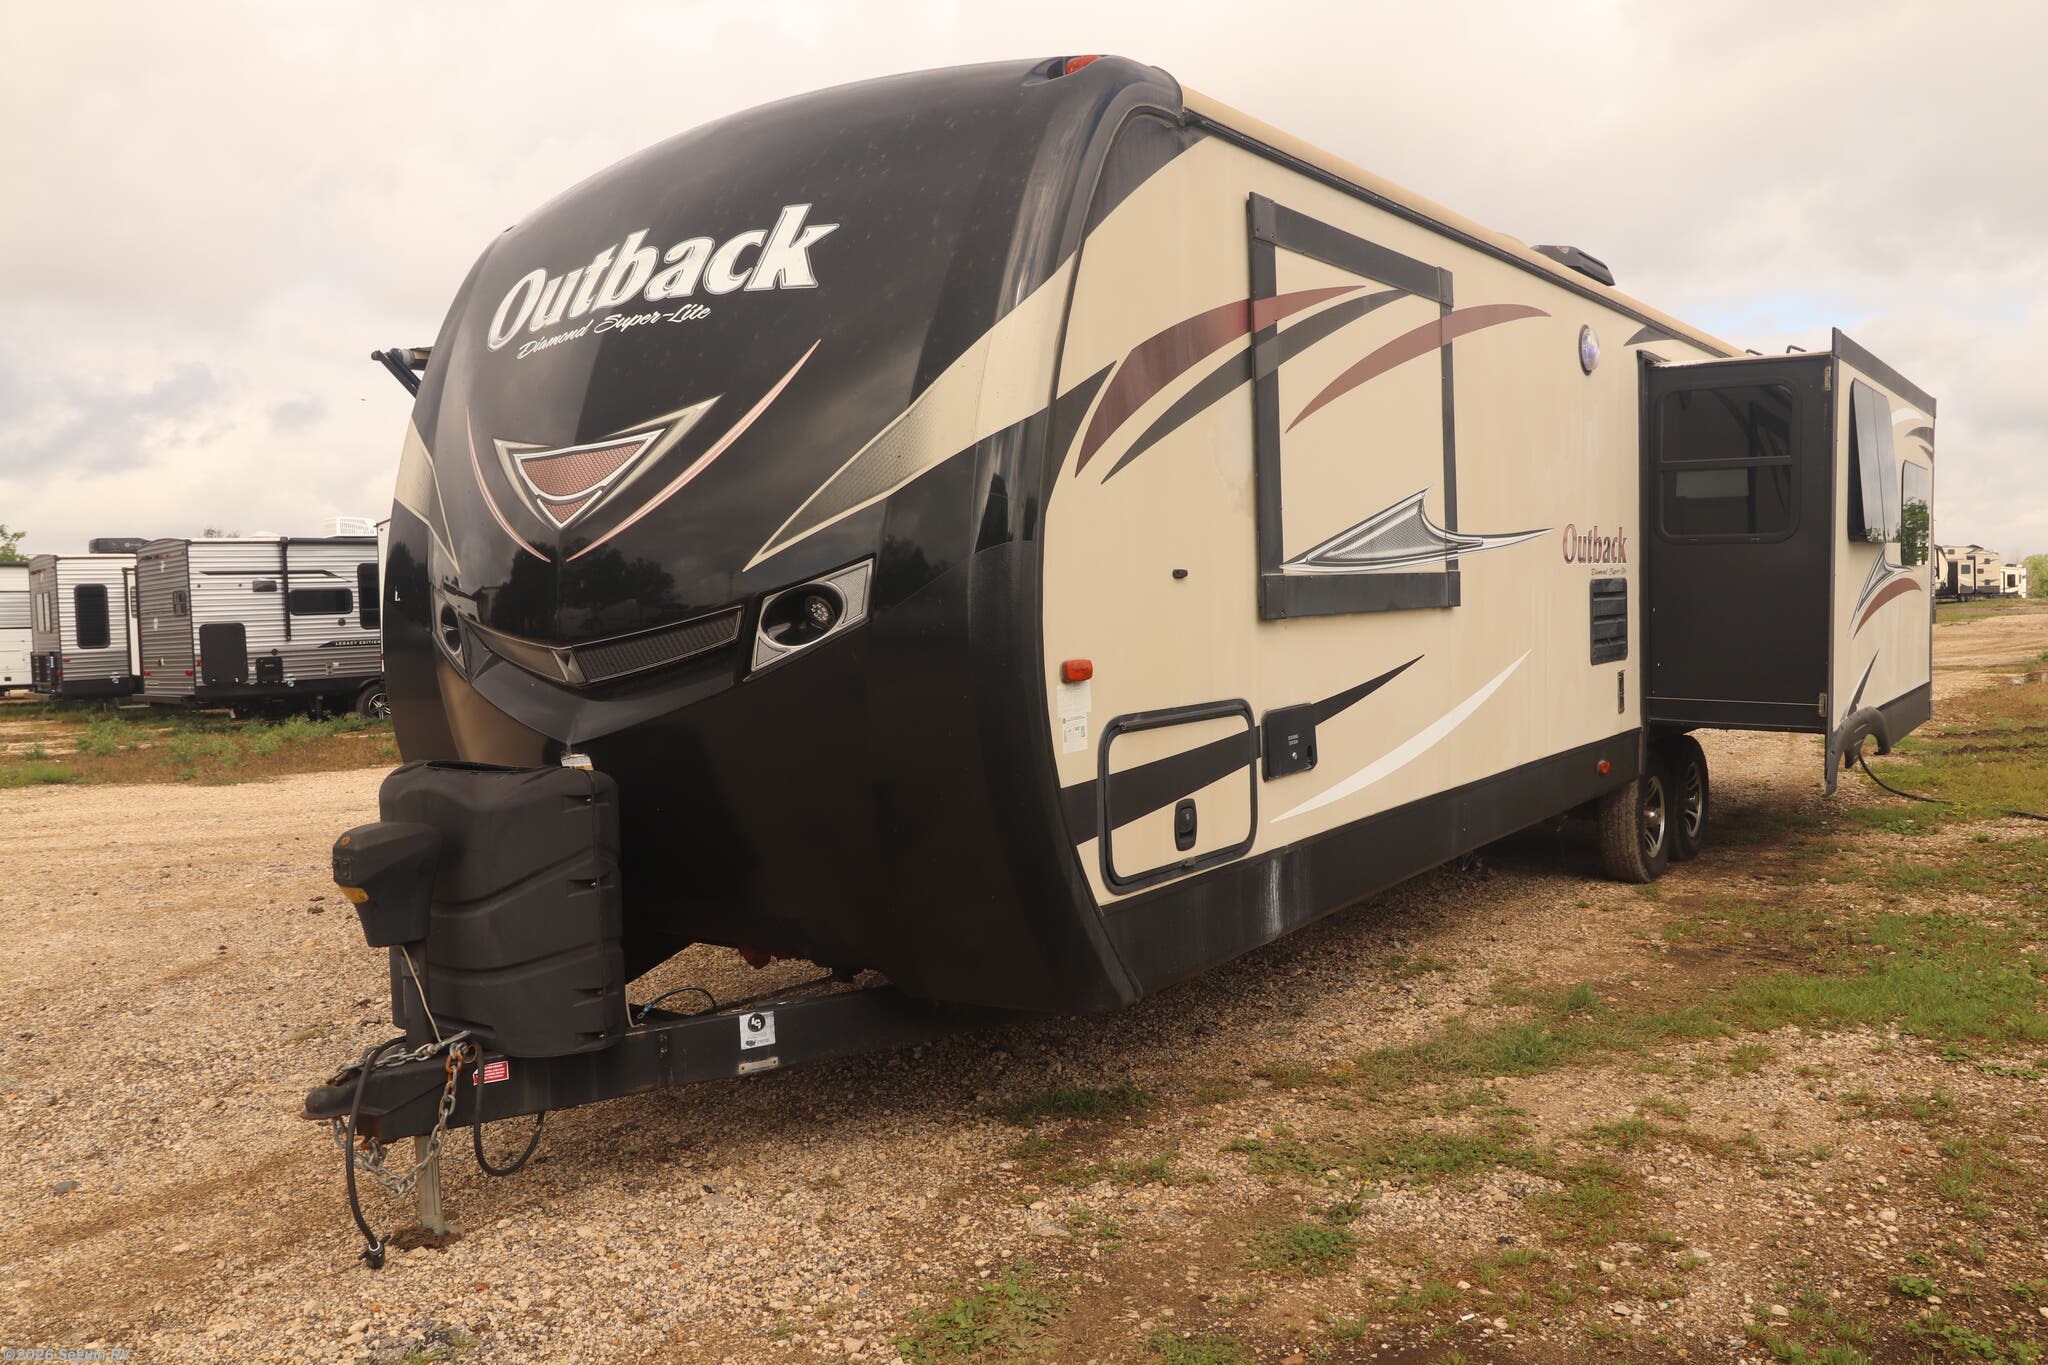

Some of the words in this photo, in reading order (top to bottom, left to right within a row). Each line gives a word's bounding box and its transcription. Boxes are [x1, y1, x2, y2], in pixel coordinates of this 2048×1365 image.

[487, 202, 841, 353] Outback
[516, 318, 594, 361] Diamond
[594, 301, 712, 334] Super-Lite
[1562, 523, 1628, 564] Outback
